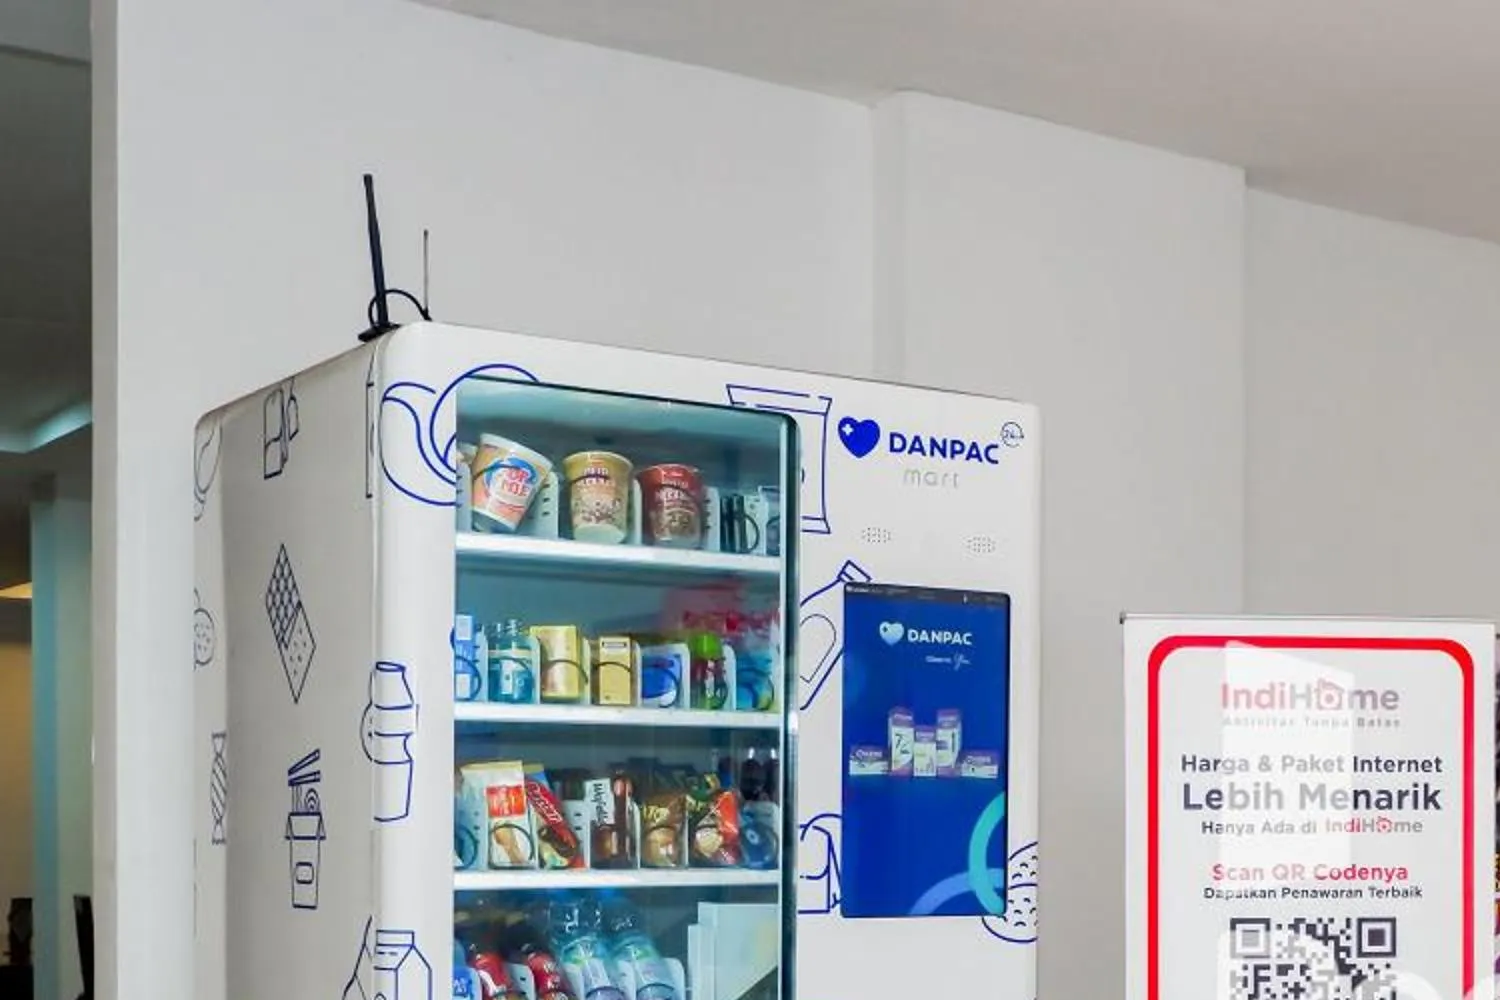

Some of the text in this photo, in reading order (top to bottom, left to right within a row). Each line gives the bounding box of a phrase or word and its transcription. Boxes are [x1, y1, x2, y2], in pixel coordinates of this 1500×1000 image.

[889, 431, 999, 465] DANPAC
[902, 466, 960, 489] mart
[907, 628, 972, 646] DANPAC
[1221, 679, 1400, 711] IndiHome
[1181, 754, 1443, 776] Harga & Paket Internet
[1183, 781, 1442, 811] Lebih Menarik
[1202, 815, 1424, 836] Hanya Ada di IndiHome
[1212, 863, 1409, 884] Scan QR Codenya
[1203, 887, 1423, 900] Dapatkan Penawaran Terbaik
